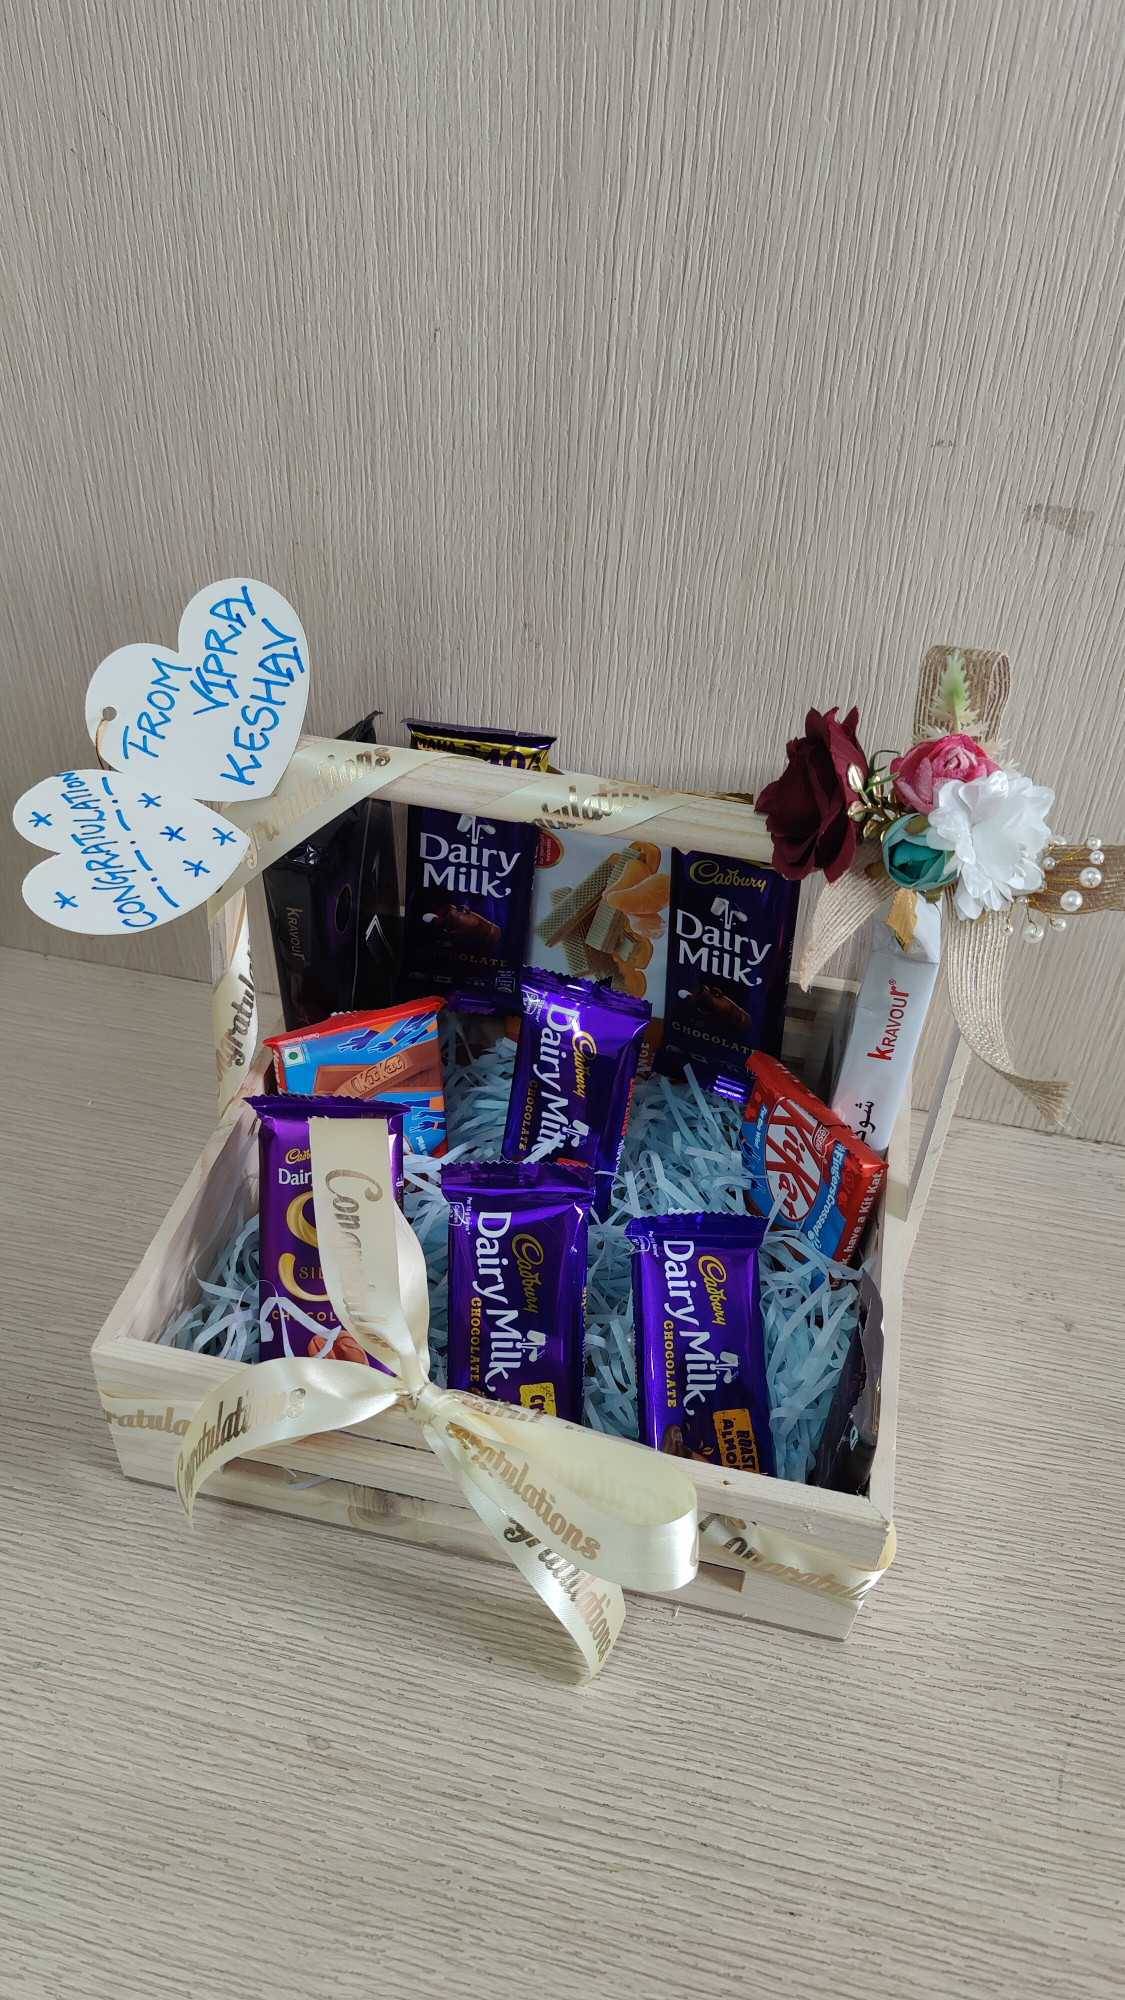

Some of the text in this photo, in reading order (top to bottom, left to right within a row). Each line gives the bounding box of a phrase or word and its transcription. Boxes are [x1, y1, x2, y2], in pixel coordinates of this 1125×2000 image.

[122, 657, 192, 759] FROM
[219, 617, 306, 786] KESHAV
[241, 746, 391, 870] gratulations
[419, 831, 522, 877] Dairy
[422, 863, 513, 899] Milk
[689, 860, 767, 892] Cadbury
[676, 908, 772, 966] Dairy
[678, 939, 763, 987] Milk
[533, 1003, 581, 1093] Dairy
[571, 1031, 597, 1098] Cadbury
[518, 1079, 539, 1151] CHOCOLATE
[756, 1117, 764, 1130] the
[760, 1105, 768, 1117] For
[278, 1167, 312, 1186] Dair
[285, 1148, 311, 1165] Cadb
[858, 1215, 866, 1225] a
[860, 1197, 873, 1213] Kit
[472, 1211, 512, 1304] Dairy
[845, 1226, 861, 1252] have
[299, 1266, 324, 1280] SIL
[511, 1233, 544, 1314] Cadbury
[698, 1255, 727, 1326] Cadbury
[469, 1297, 483, 1383] CHOCOLATE
[484, 1308, 523, 1392] Milk
[663, 1240, 717, 1416] Dairy Milk
[663, 1319, 678, 1408] CHOCOLATE
[722, 1418, 740, 1470] ALMO
[736, 1430, 757, 1470] ROAST
